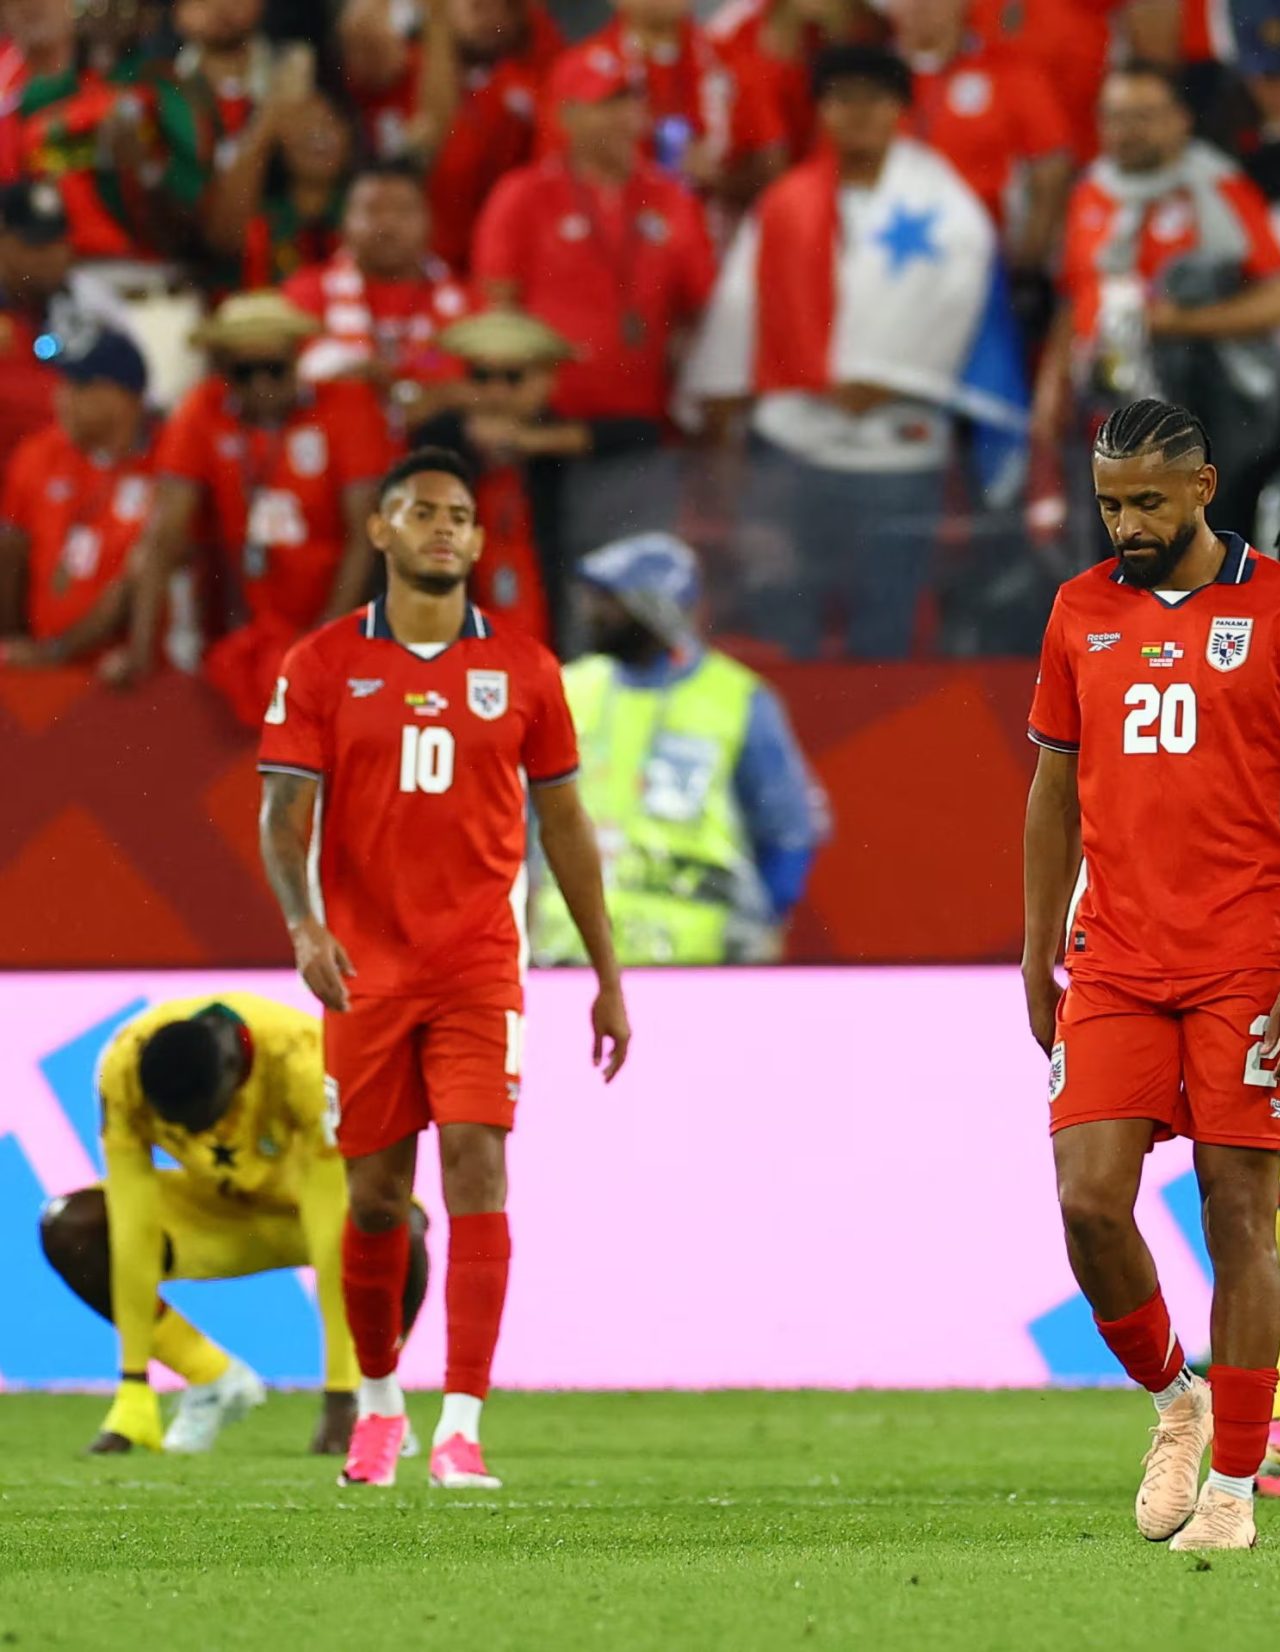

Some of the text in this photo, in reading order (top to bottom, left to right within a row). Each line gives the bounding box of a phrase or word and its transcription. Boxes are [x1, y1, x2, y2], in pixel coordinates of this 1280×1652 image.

[1087, 632, 1121, 642] Reebok
[1123, 683, 1197, 754] 20
[400, 724, 455, 794] 10
[504, 1009, 526, 1076] 1
